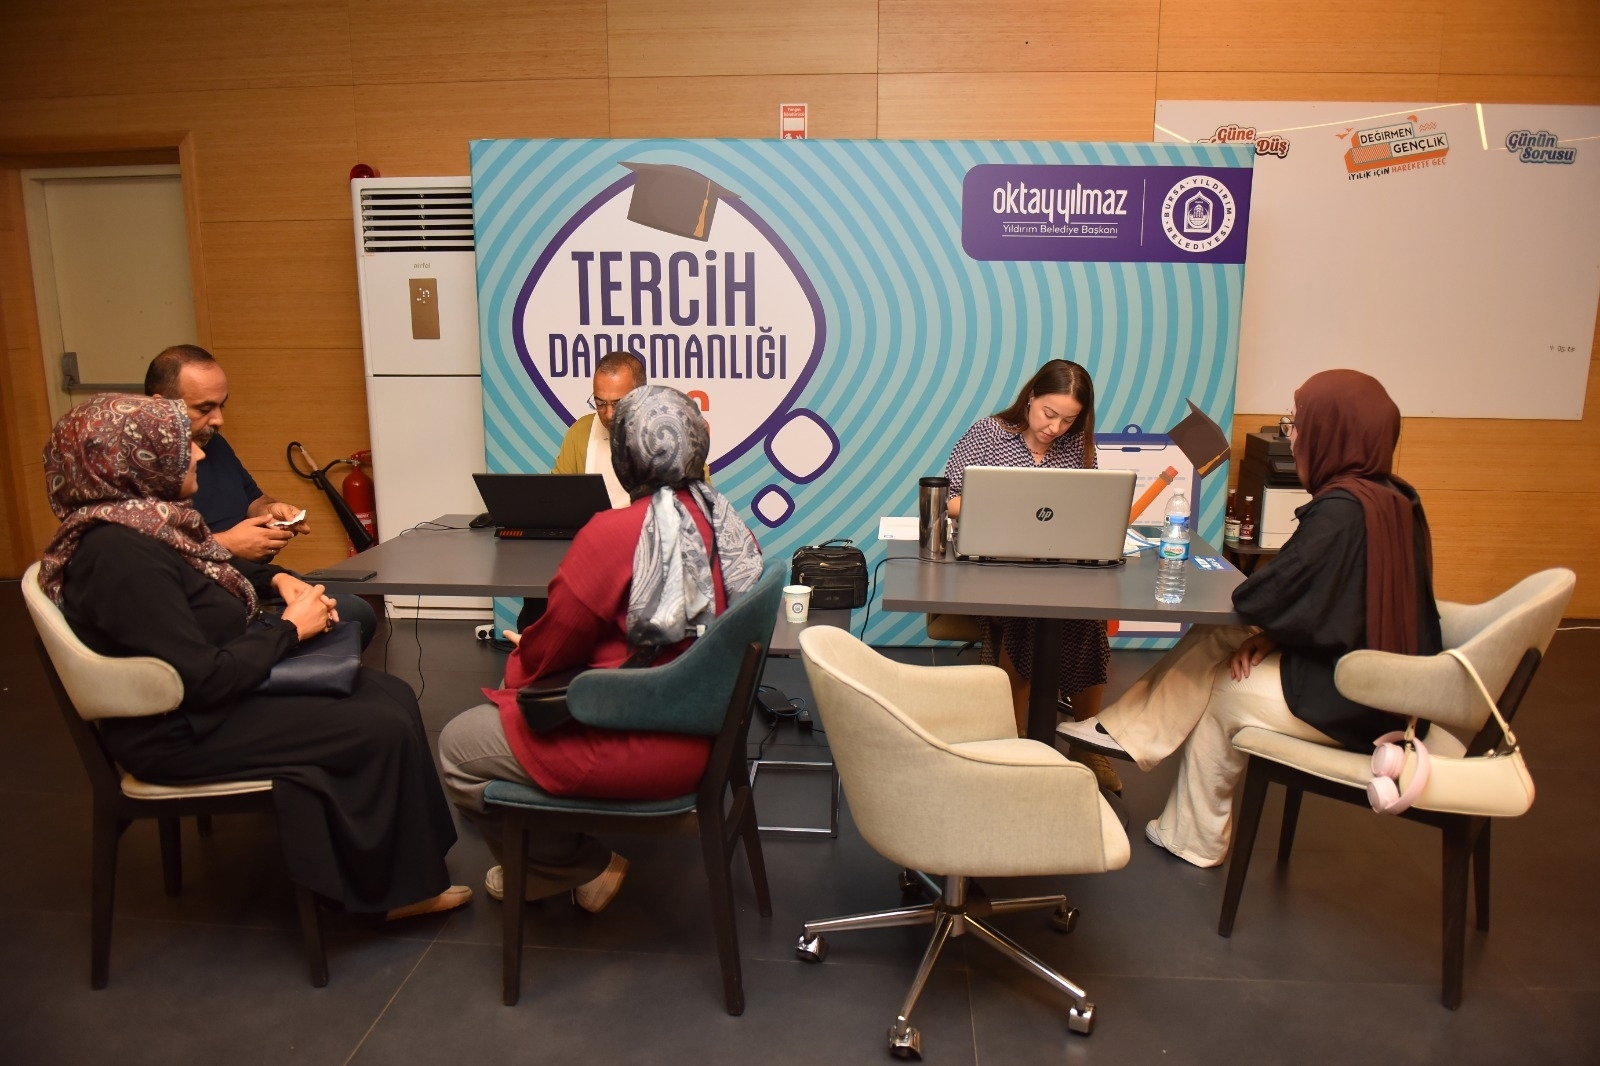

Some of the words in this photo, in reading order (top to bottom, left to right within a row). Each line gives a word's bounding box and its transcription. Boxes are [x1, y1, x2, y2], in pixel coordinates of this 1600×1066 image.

[1217, 127, 1254, 144] Güne
[1508, 133, 1556, 149] Günün
[1257, 138, 1287, 156] Düş
[1522, 147, 1574, 161] Sorusu
[1391, 160, 1430, 173] HAREKETE
[1432, 158, 1447, 167] GEÇ
[993, 181, 1055, 224] oktay
[1056, 182, 1128, 224] yılmaz
[1164, 184, 1186, 218] BURSA
[1192, 178, 1232, 215] YILDIRIM
[1003, 224, 1038, 233] Yıldırım
[1040, 224, 1079, 235] Belediye
[1081, 225, 1118, 235] Başkanı
[1037, 507, 1053, 521] hp
